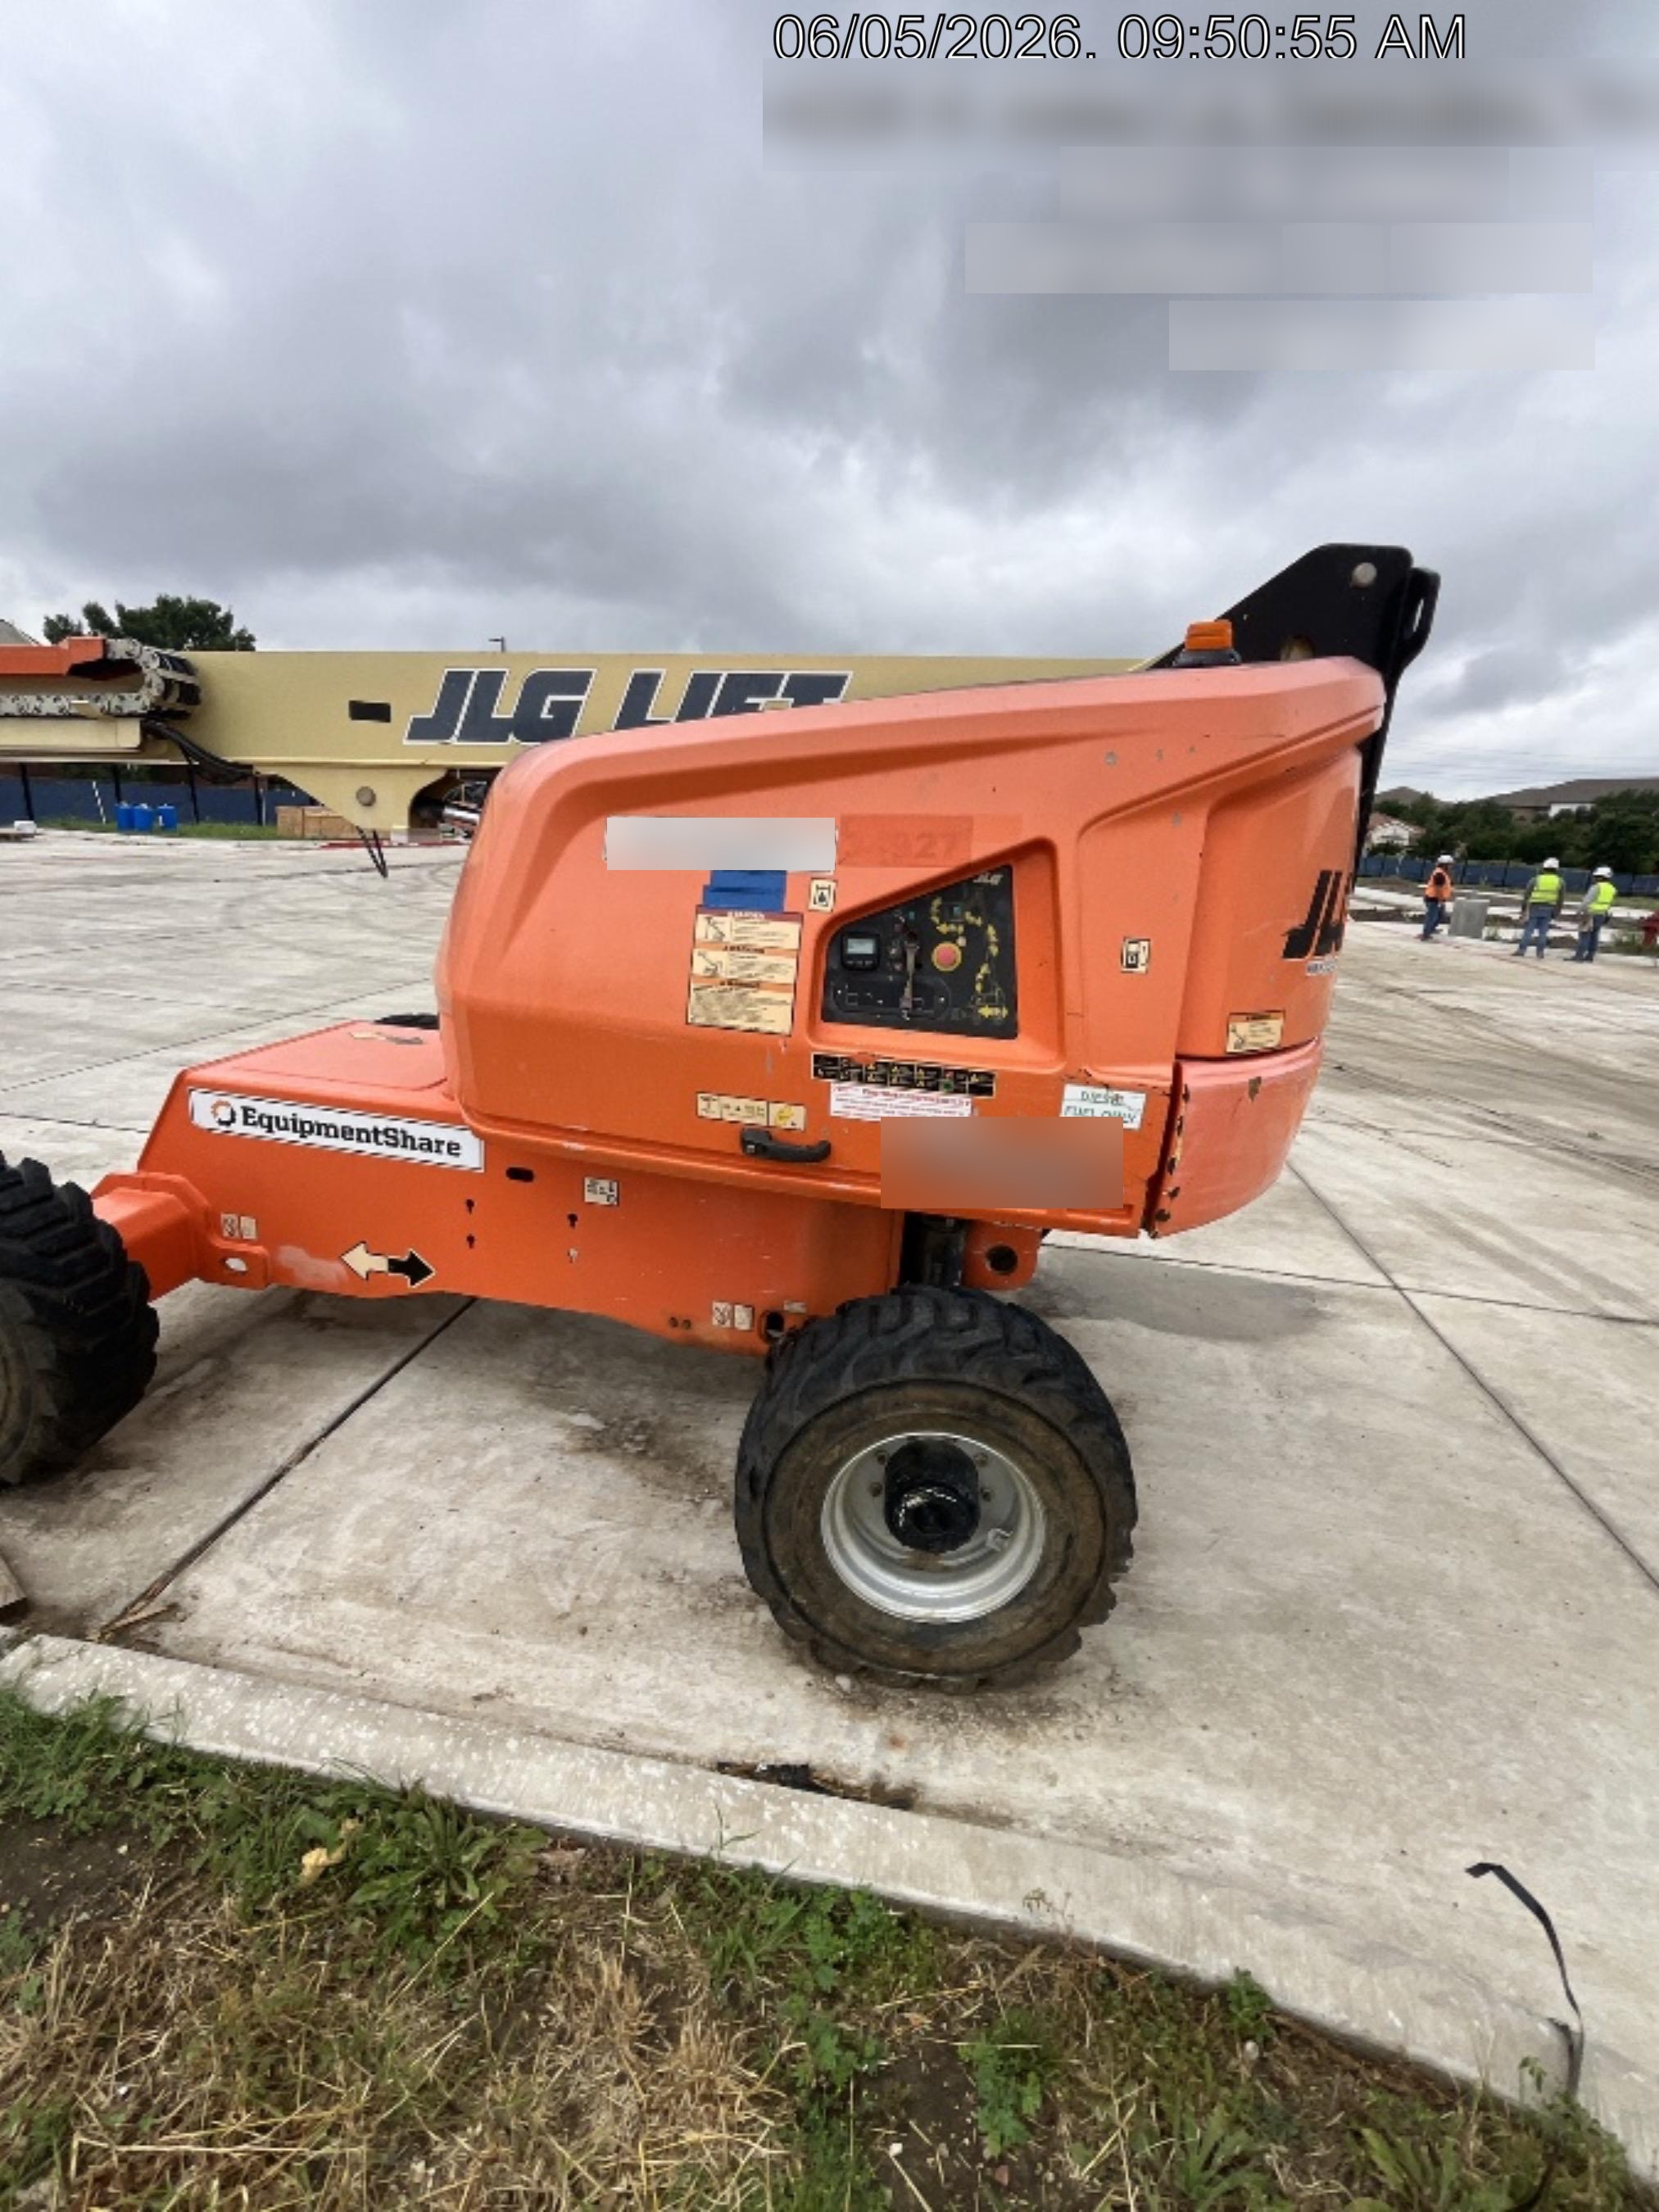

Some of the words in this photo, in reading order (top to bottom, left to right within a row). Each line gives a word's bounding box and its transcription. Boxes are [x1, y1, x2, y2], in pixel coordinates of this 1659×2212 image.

[402, 668, 597, 745] JLG
[611, 669, 854, 732] LIFT
[240, 1105, 461, 1157] EquipmentShare
